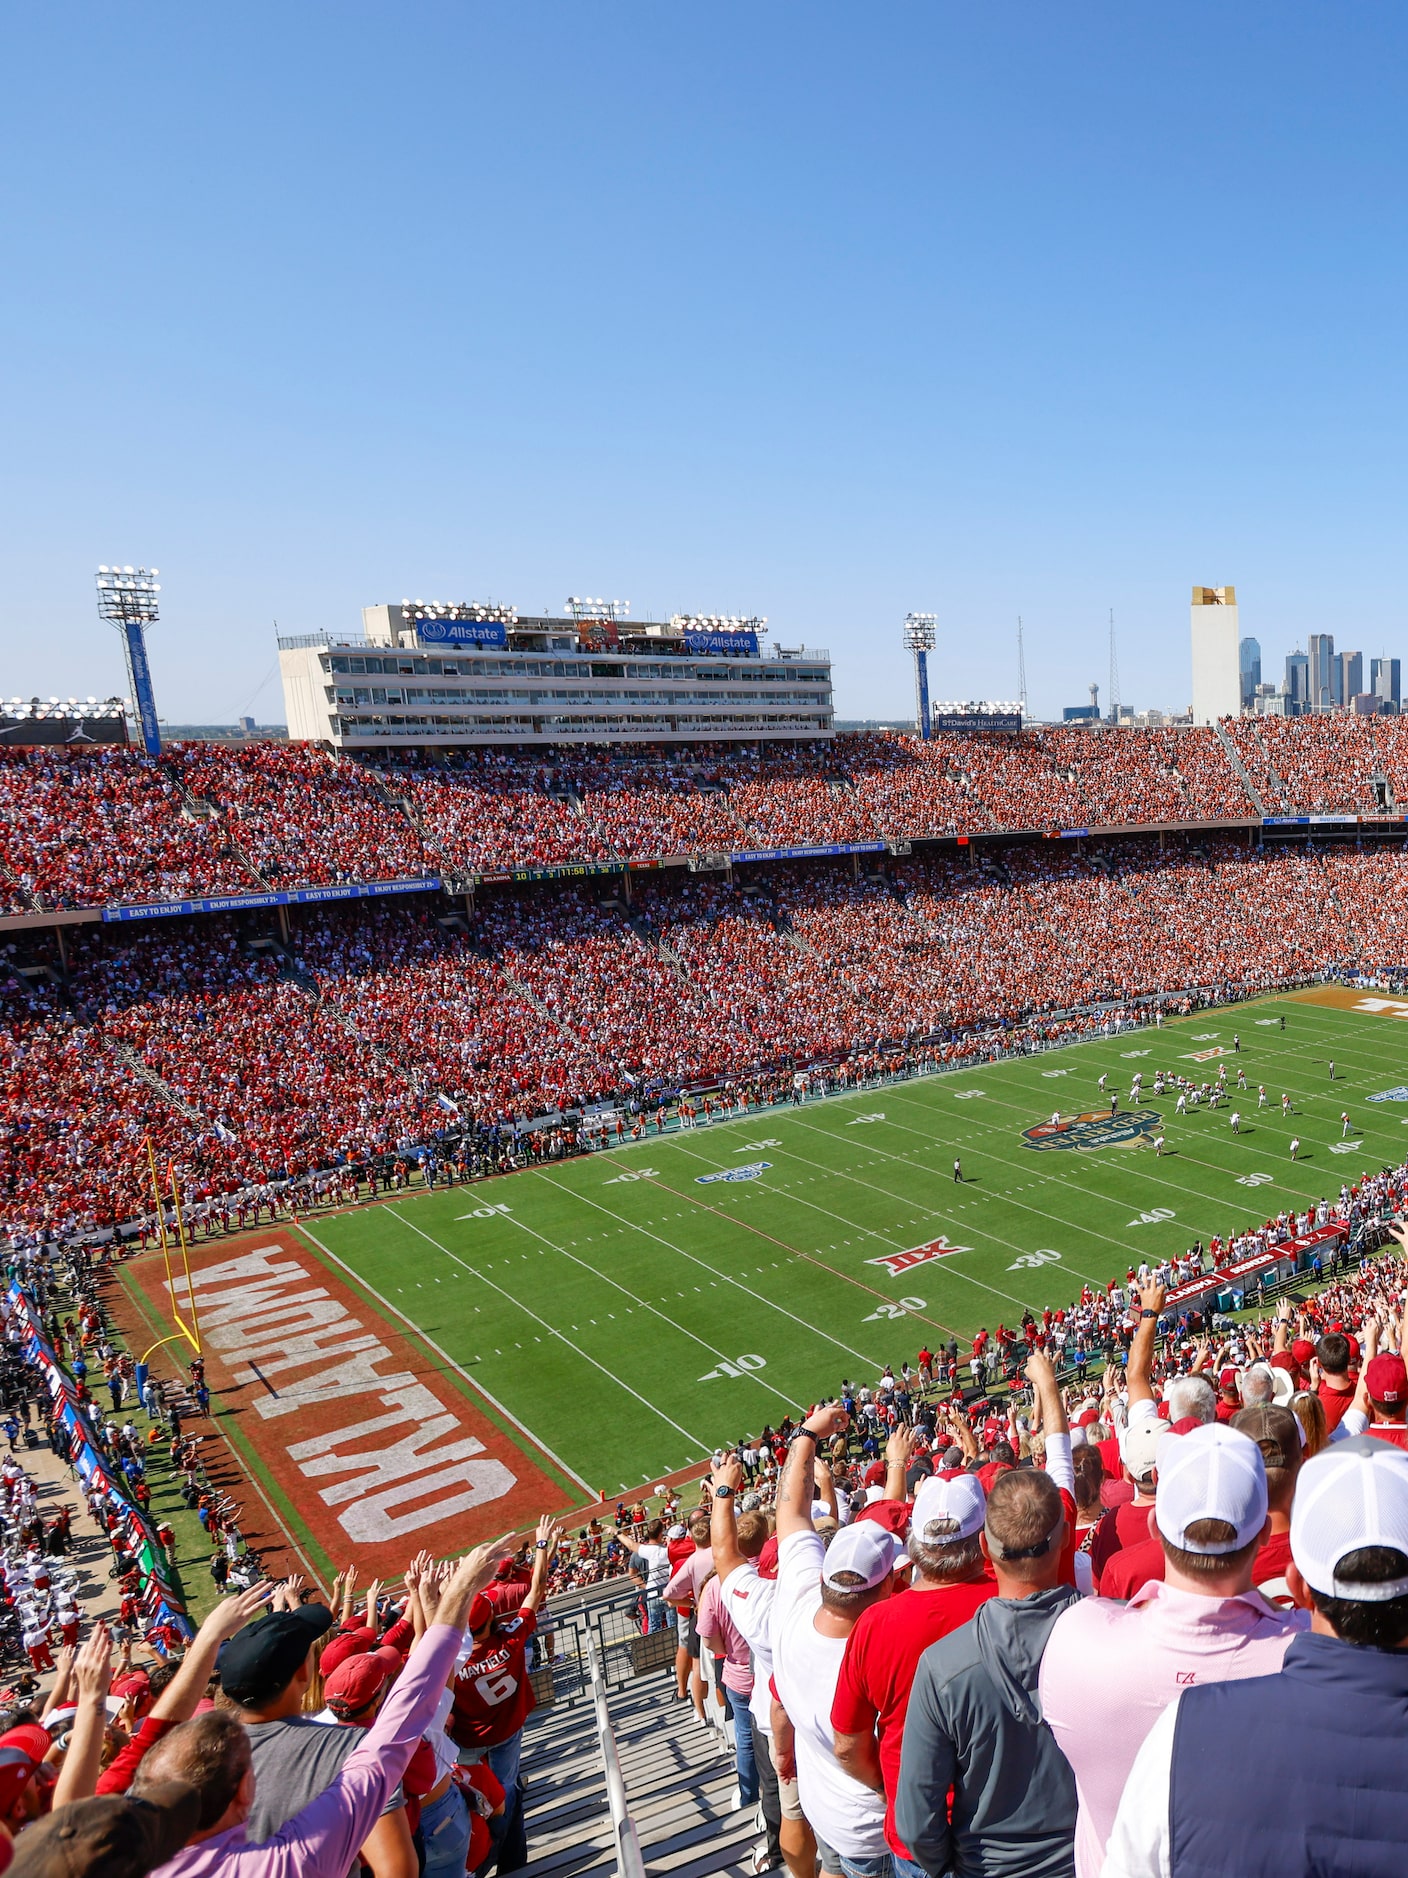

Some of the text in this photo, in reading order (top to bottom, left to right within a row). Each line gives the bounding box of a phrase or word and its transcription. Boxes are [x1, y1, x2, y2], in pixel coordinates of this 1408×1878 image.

[448, 626, 499, 640] Allstate
[709, 637, 751, 648] Allstate
[561, 866, 585, 877] 11:58
[393, 883, 426, 891] RESPONSIBLY
[306, 892, 322, 900] EASY
[332, 889, 351, 897] ENJOY
[230, 898, 268, 907] RESPONSIBLY
[130, 905, 182, 917] EASY TO ENJOY
[954, 1090, 986, 1099] 50
[856, 1113, 885, 1124] 40
[1030, 1112, 1156, 1148] RED RIVER
[746, 1138, 782, 1150] 30
[618, 1168, 660, 1181] 20
[1234, 1172, 1274, 1187] 50
[473, 1203, 514, 1218] 10
[1138, 1207, 1176, 1223] 40
[1016, 1249, 1062, 1268] 30
[1230, 1254, 1274, 1275] SOONERS
[876, 1296, 927, 1320] 20
[715, 1354, 766, 1378] 10
[164, 1244, 519, 1543] OKLAHOMA
[458, 1649, 510, 1681] MAYFIELD
[474, 1668, 518, 1706] 6
